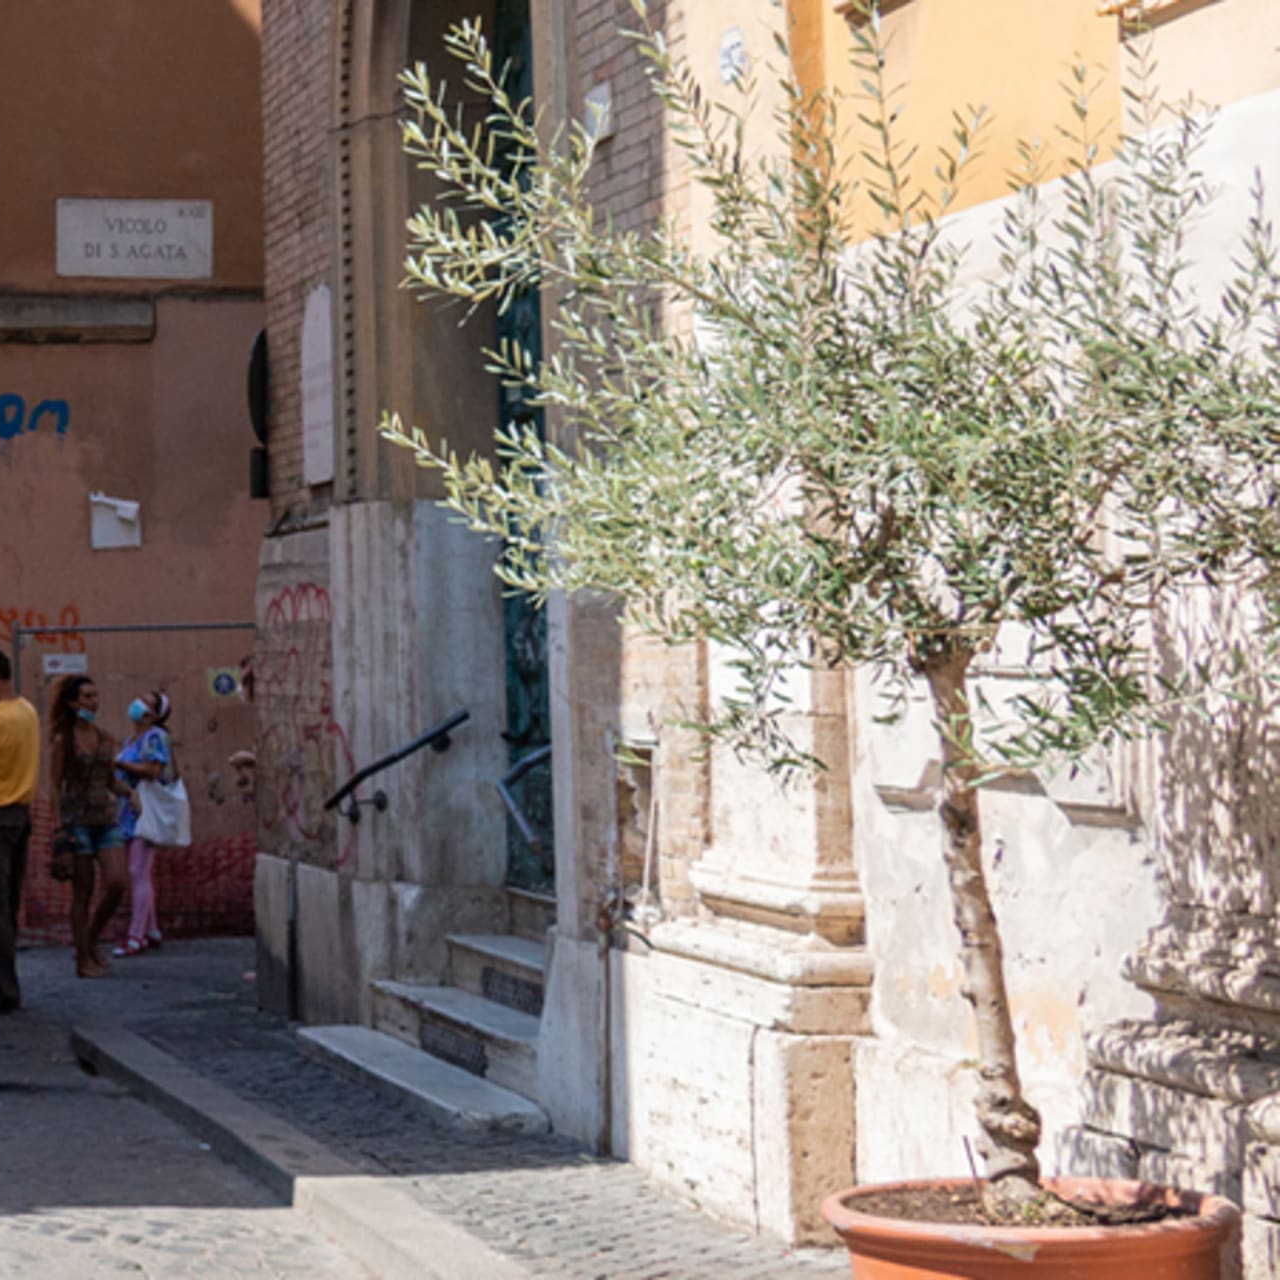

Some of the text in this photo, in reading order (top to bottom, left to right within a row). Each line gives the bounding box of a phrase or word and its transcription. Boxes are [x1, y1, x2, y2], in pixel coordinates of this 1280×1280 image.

[104, 217, 168, 235] VICOLO
[84, 242, 102, 259] DI
[127, 243, 188, 260] AGATA
